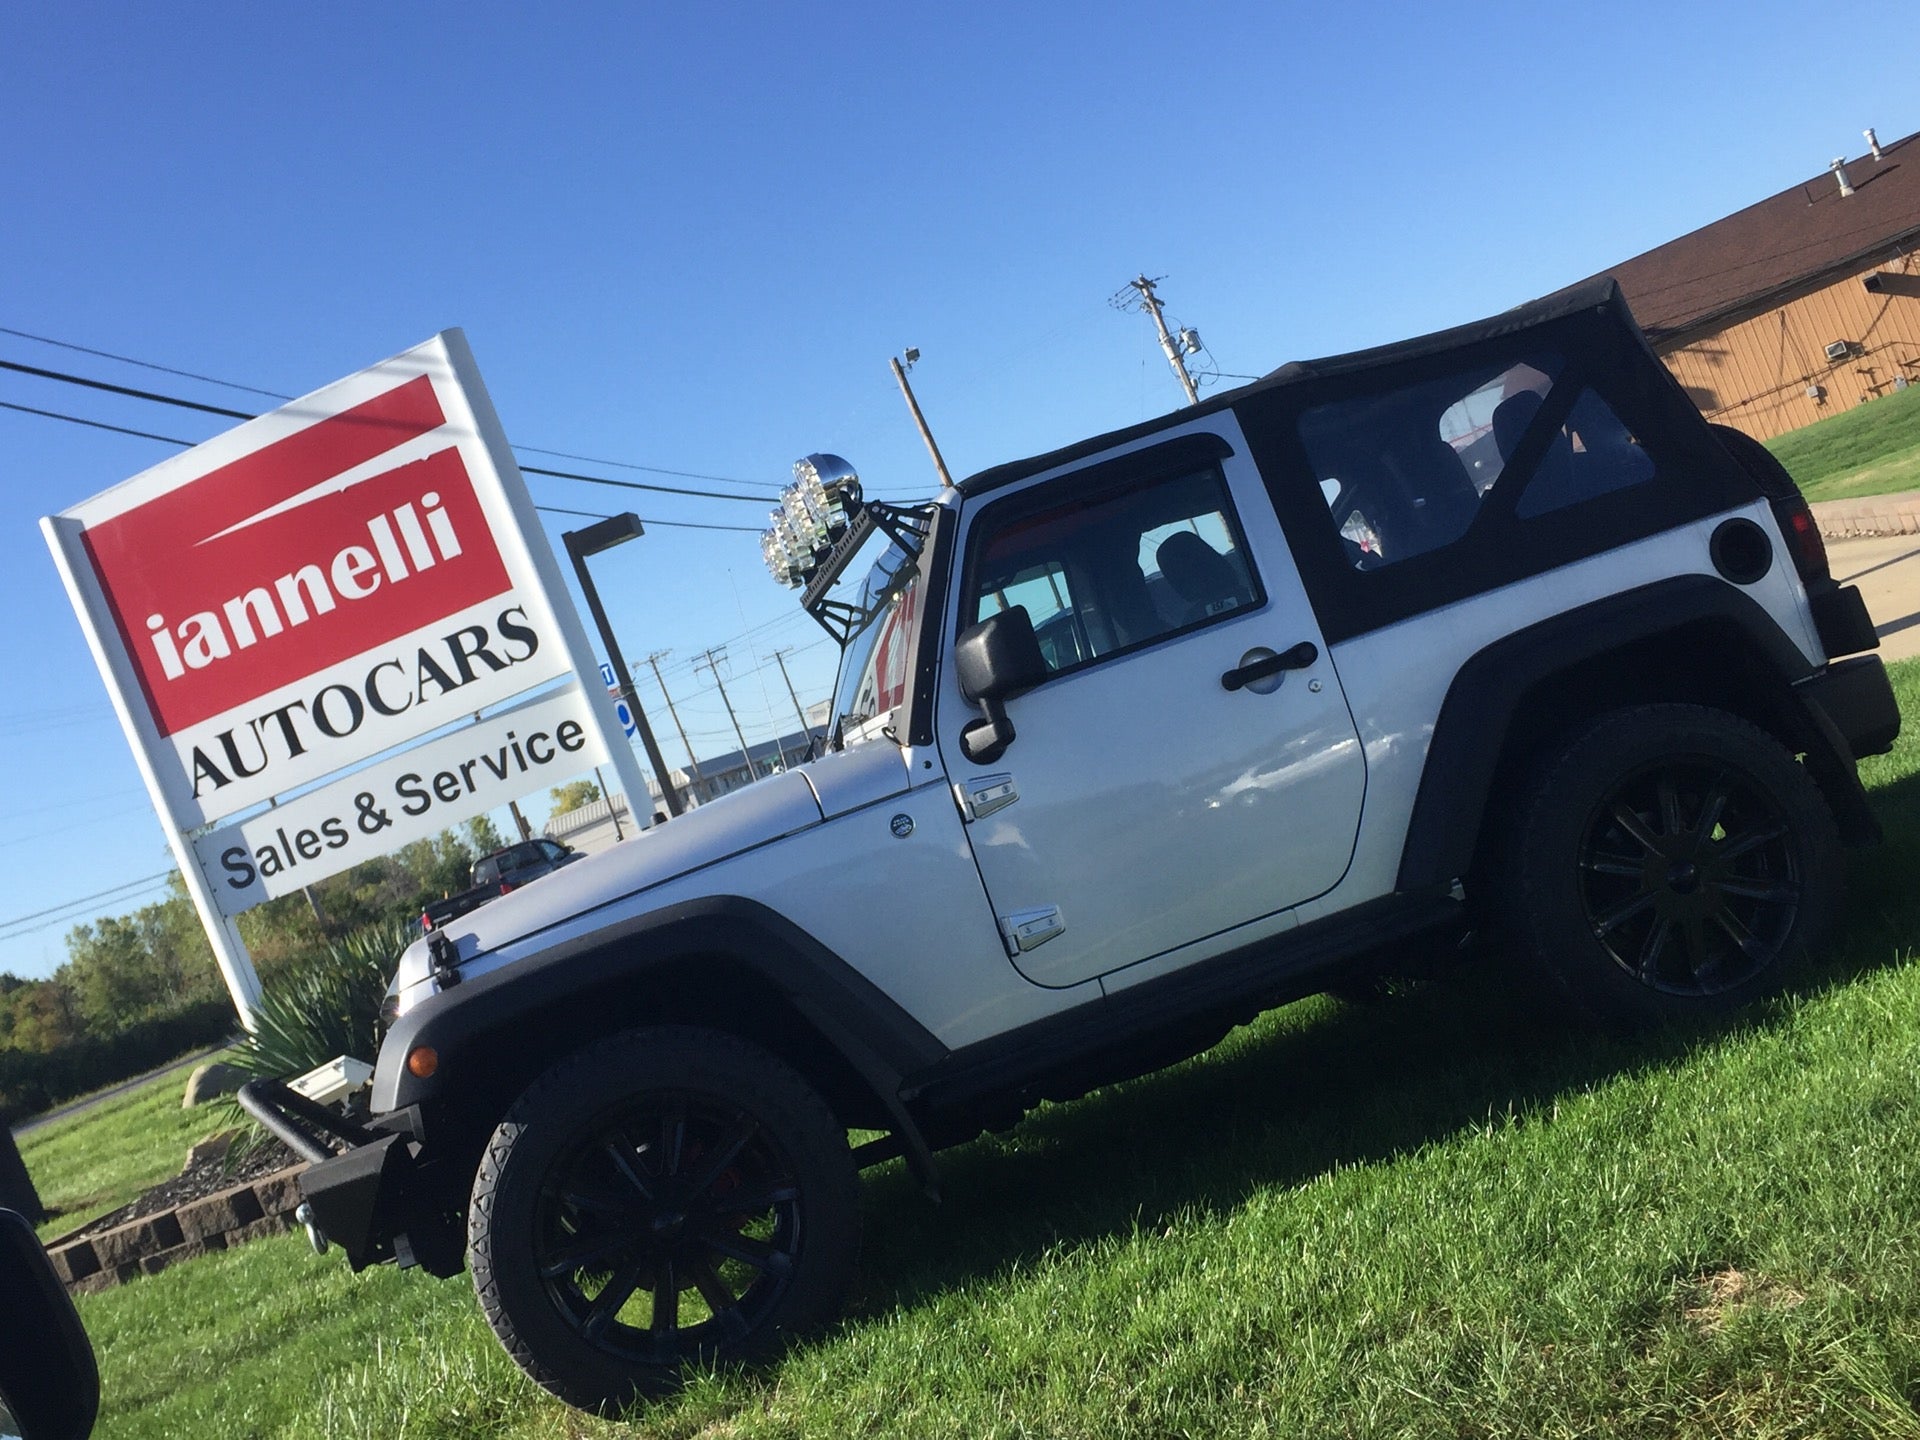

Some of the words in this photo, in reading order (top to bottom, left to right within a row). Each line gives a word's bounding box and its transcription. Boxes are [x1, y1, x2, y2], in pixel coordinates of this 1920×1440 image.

[146, 491, 462, 681] iannelli
[191, 604, 539, 799] AUTOCARS
[220, 816, 350, 889] Sales
[354, 792, 393, 835] &
[395, 719, 586, 816] Service
